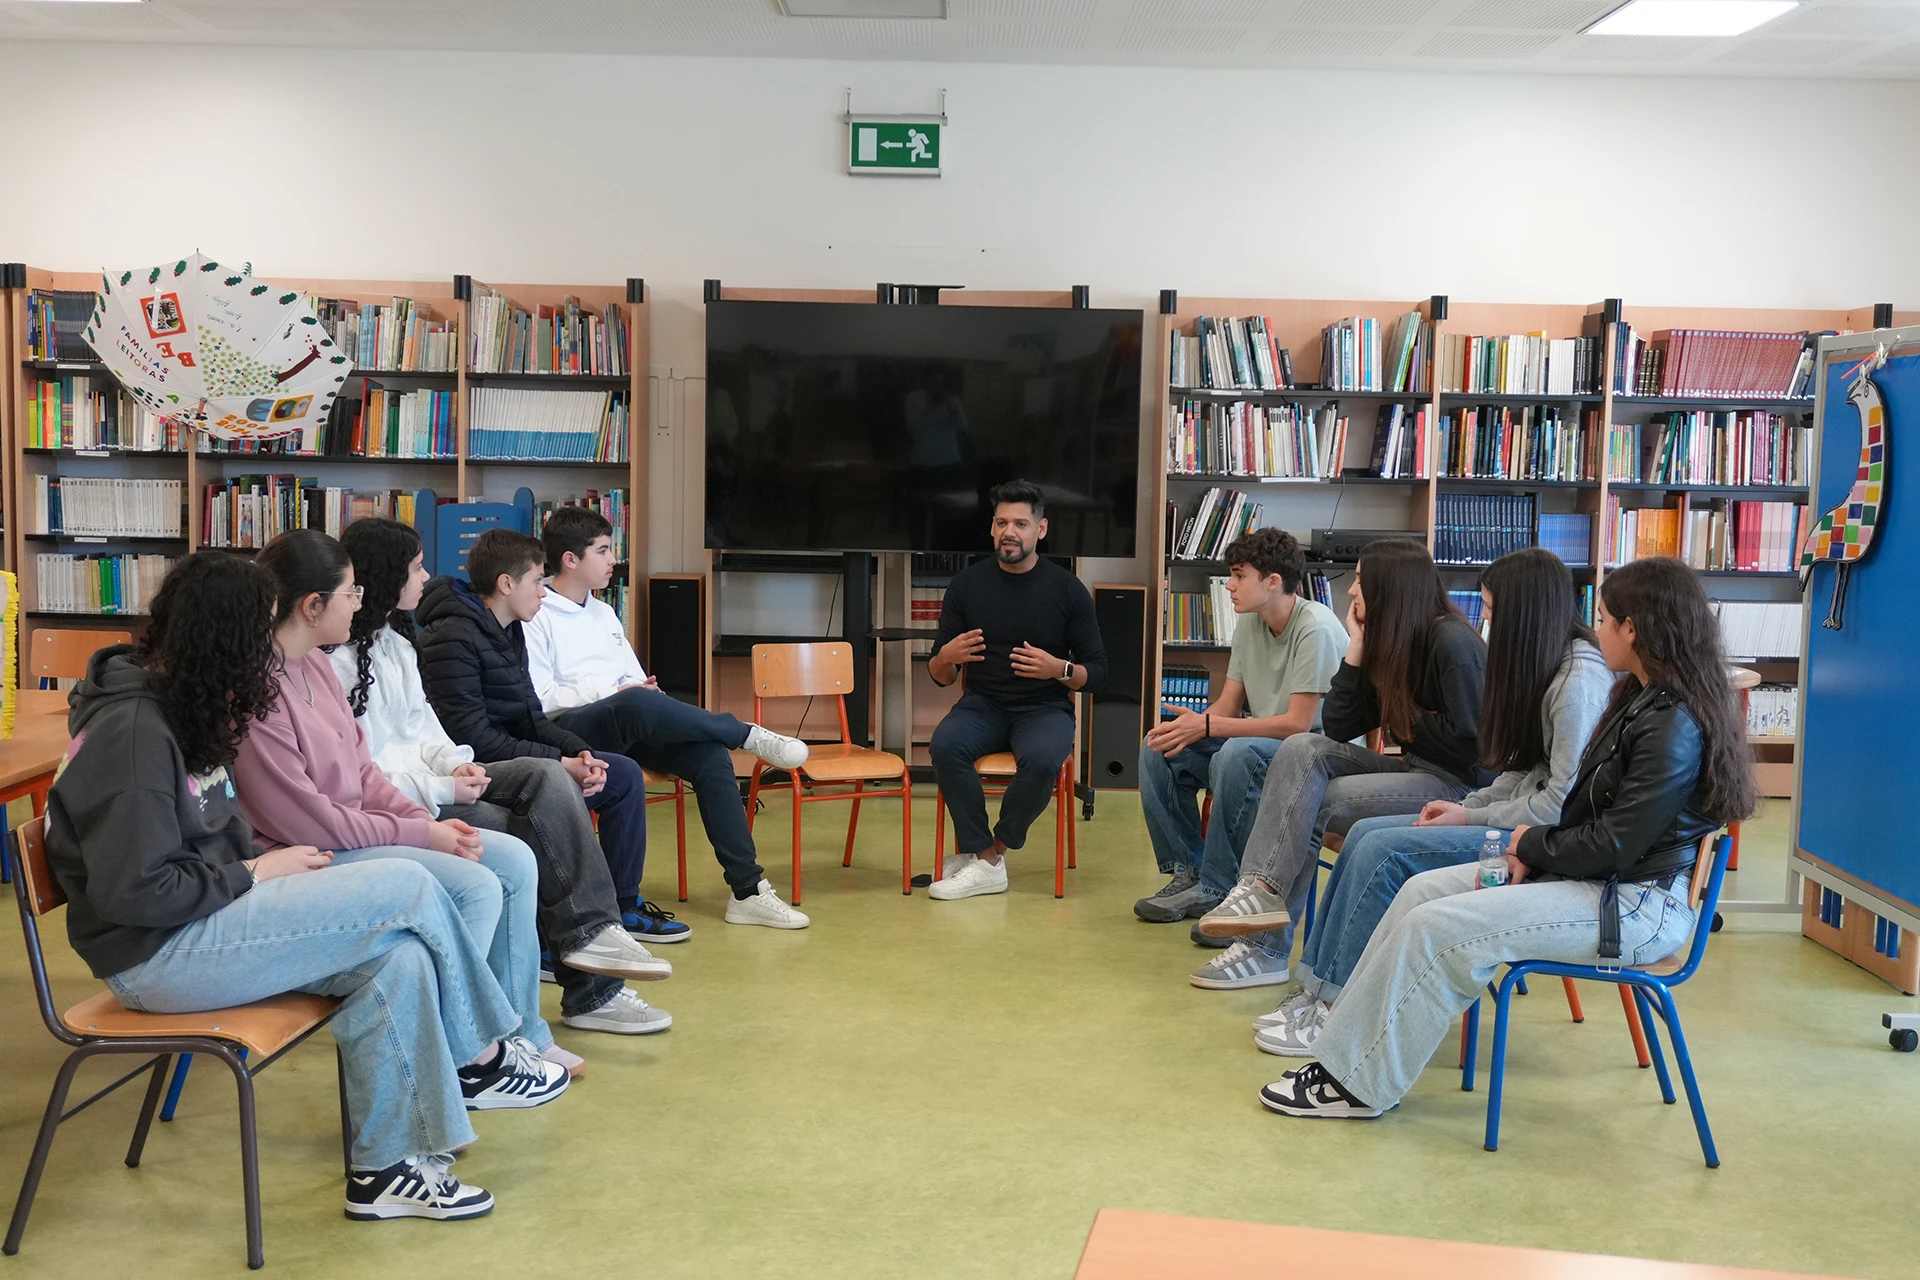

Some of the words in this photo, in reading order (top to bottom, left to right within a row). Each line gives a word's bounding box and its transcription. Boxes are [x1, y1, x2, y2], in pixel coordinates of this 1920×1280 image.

[116, 339, 165, 382] LEITORAS
[121, 325, 169, 374] FAMILIAS
[1186, 516, 1195, 533] NIKON
